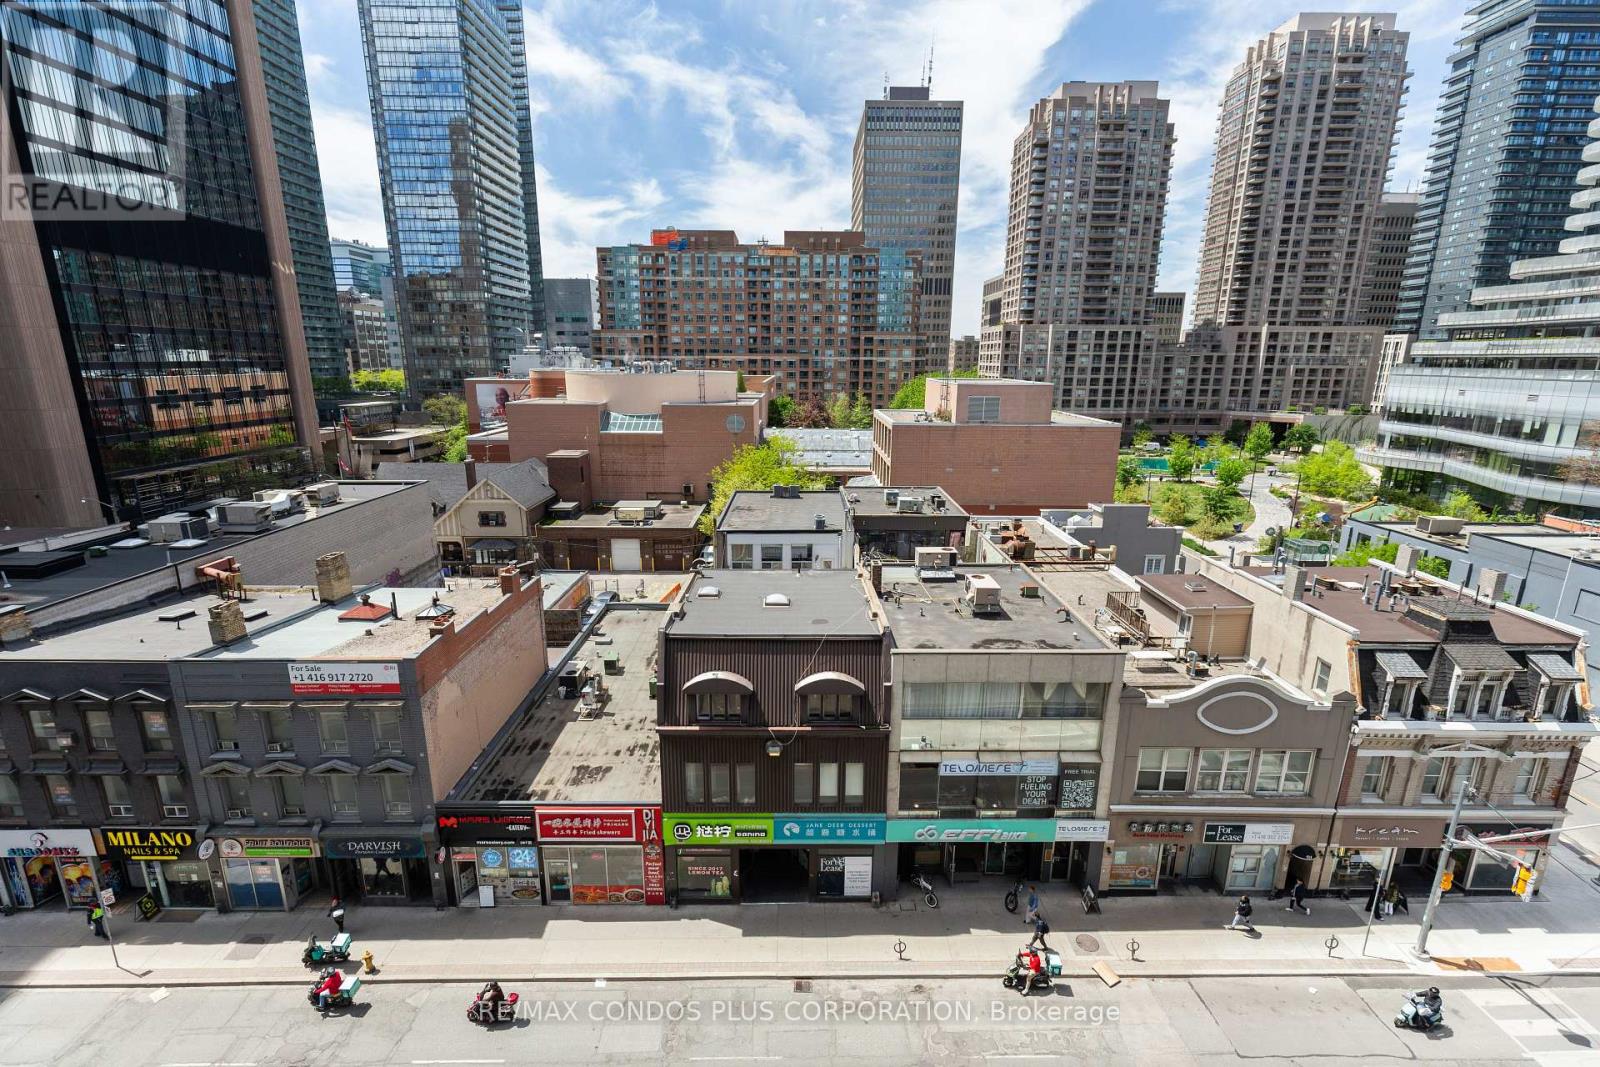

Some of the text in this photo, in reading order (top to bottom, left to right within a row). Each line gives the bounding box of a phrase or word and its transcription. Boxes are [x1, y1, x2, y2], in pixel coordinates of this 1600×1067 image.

[293, 673, 373, 682] +1 416 917 2720
[1026, 775, 1047, 783] STOP
[1022, 797, 1047, 805] DEATH
[1217, 825, 1233, 834] For
[107, 831, 192, 847] MILANO
[1216, 833, 1243, 842] Lease
[270, 839, 310, 847] BOUTIQUE
[347, 841, 401, 851] DARVISH
[124, 848, 151, 856] NAILS
[163, 848, 181, 856] SPA
